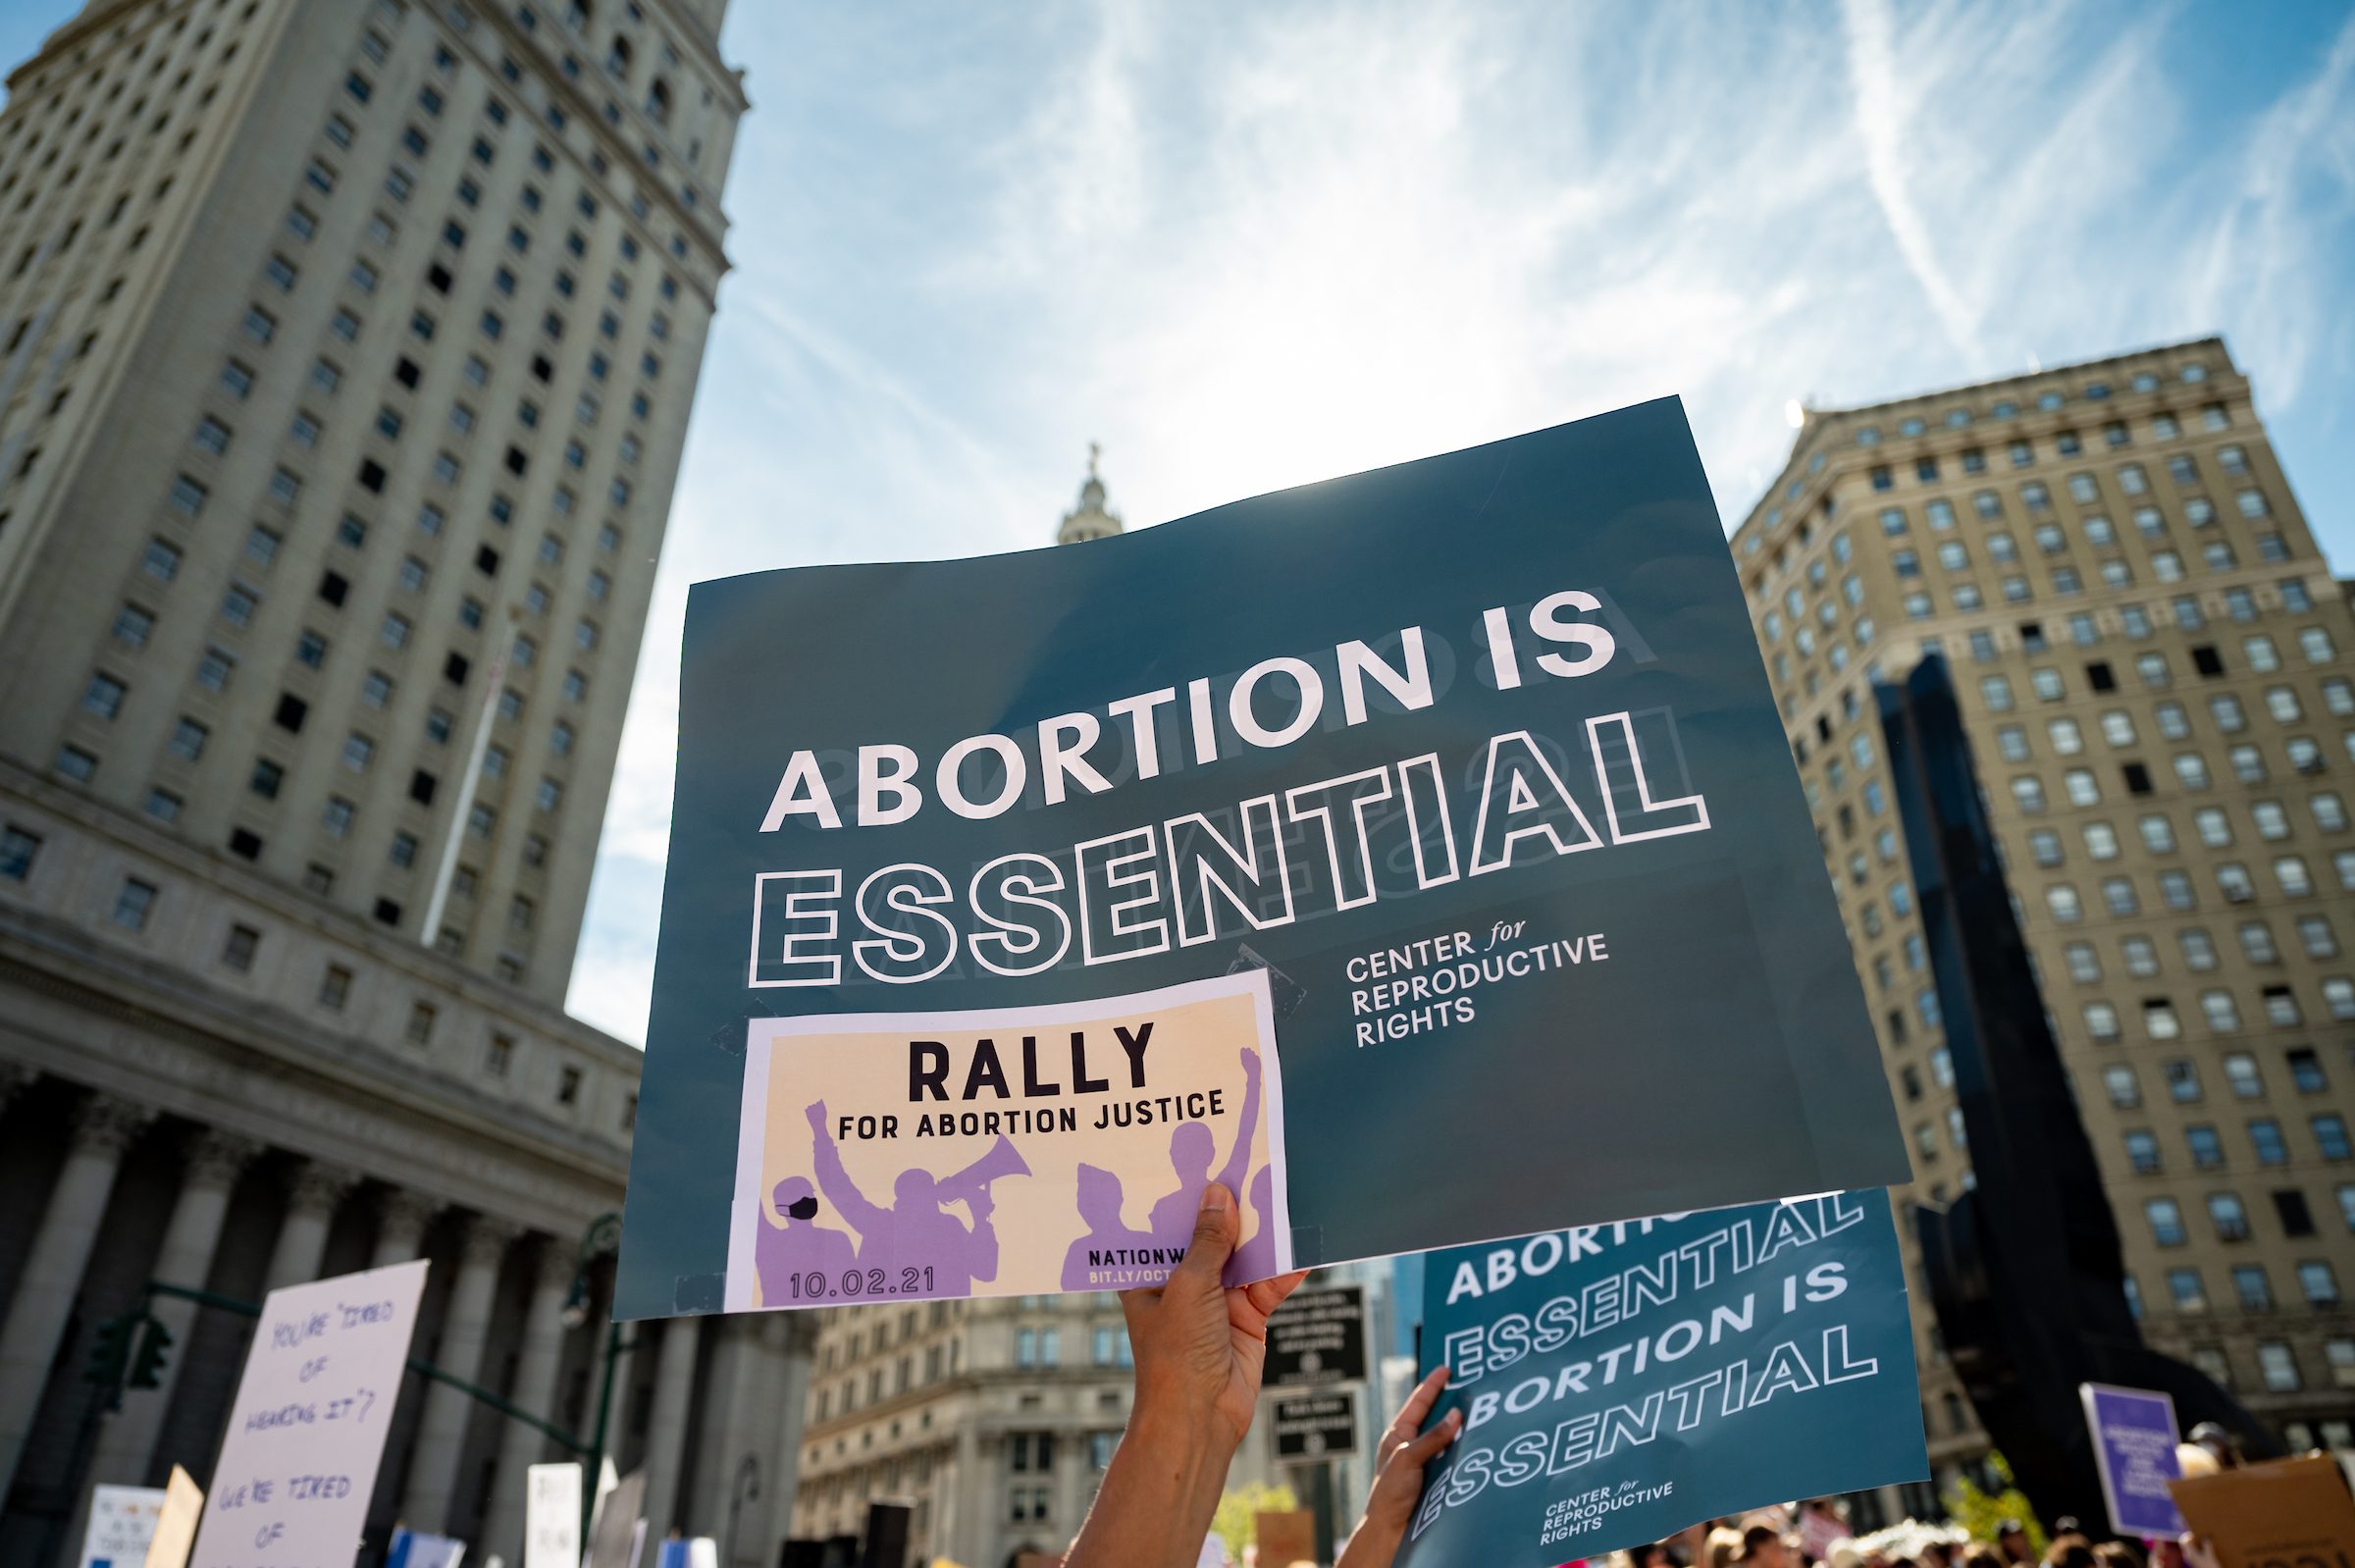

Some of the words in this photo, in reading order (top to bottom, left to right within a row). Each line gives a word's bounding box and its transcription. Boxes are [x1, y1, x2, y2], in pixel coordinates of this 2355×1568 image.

[759, 625, 1434, 833] ABORTION
[1483, 590, 1616, 690] IS
[749, 711, 1711, 989] ESSENTIAL
[1346, 931, 1476, 983] CENTER
[1484, 917, 1526, 952] for
[1352, 933, 1609, 1017] REPRODUCTIVE
[1355, 996, 1475, 1048] RIGHTS
[908, 1021, 1154, 1103] RALLY
[838, 1115, 899, 1140] FOR
[916, 1107, 1076, 1138] ABORTION
[1093, 1089, 1226, 1129] JUSTICE
[790, 1266, 933, 1299] 10.02.21
[1088, 1248, 1185, 1267] NATIONW
[1089, 1270, 1172, 1284] BIT.LY/OCT
[1446, 1212, 1694, 1305] ABOR
[1444, 1194, 1864, 1390] ESSENTIAL
[298, 1355, 330, 1384] OF
[1437, 1292, 1755, 1459] BORTION
[1783, 1262, 1848, 1314] IS
[1411, 1325, 1878, 1542] ESSENTIAL
[288, 1474, 351, 1500] TIRED
[1544, 1482, 1673, 1532] REPRODUCTIVE
[1545, 1487, 1610, 1517] CENTER
[1614, 1480, 1639, 1496] for
[255, 1522, 287, 1549] OF
[1540, 1517, 1602, 1546] RIGHTS
